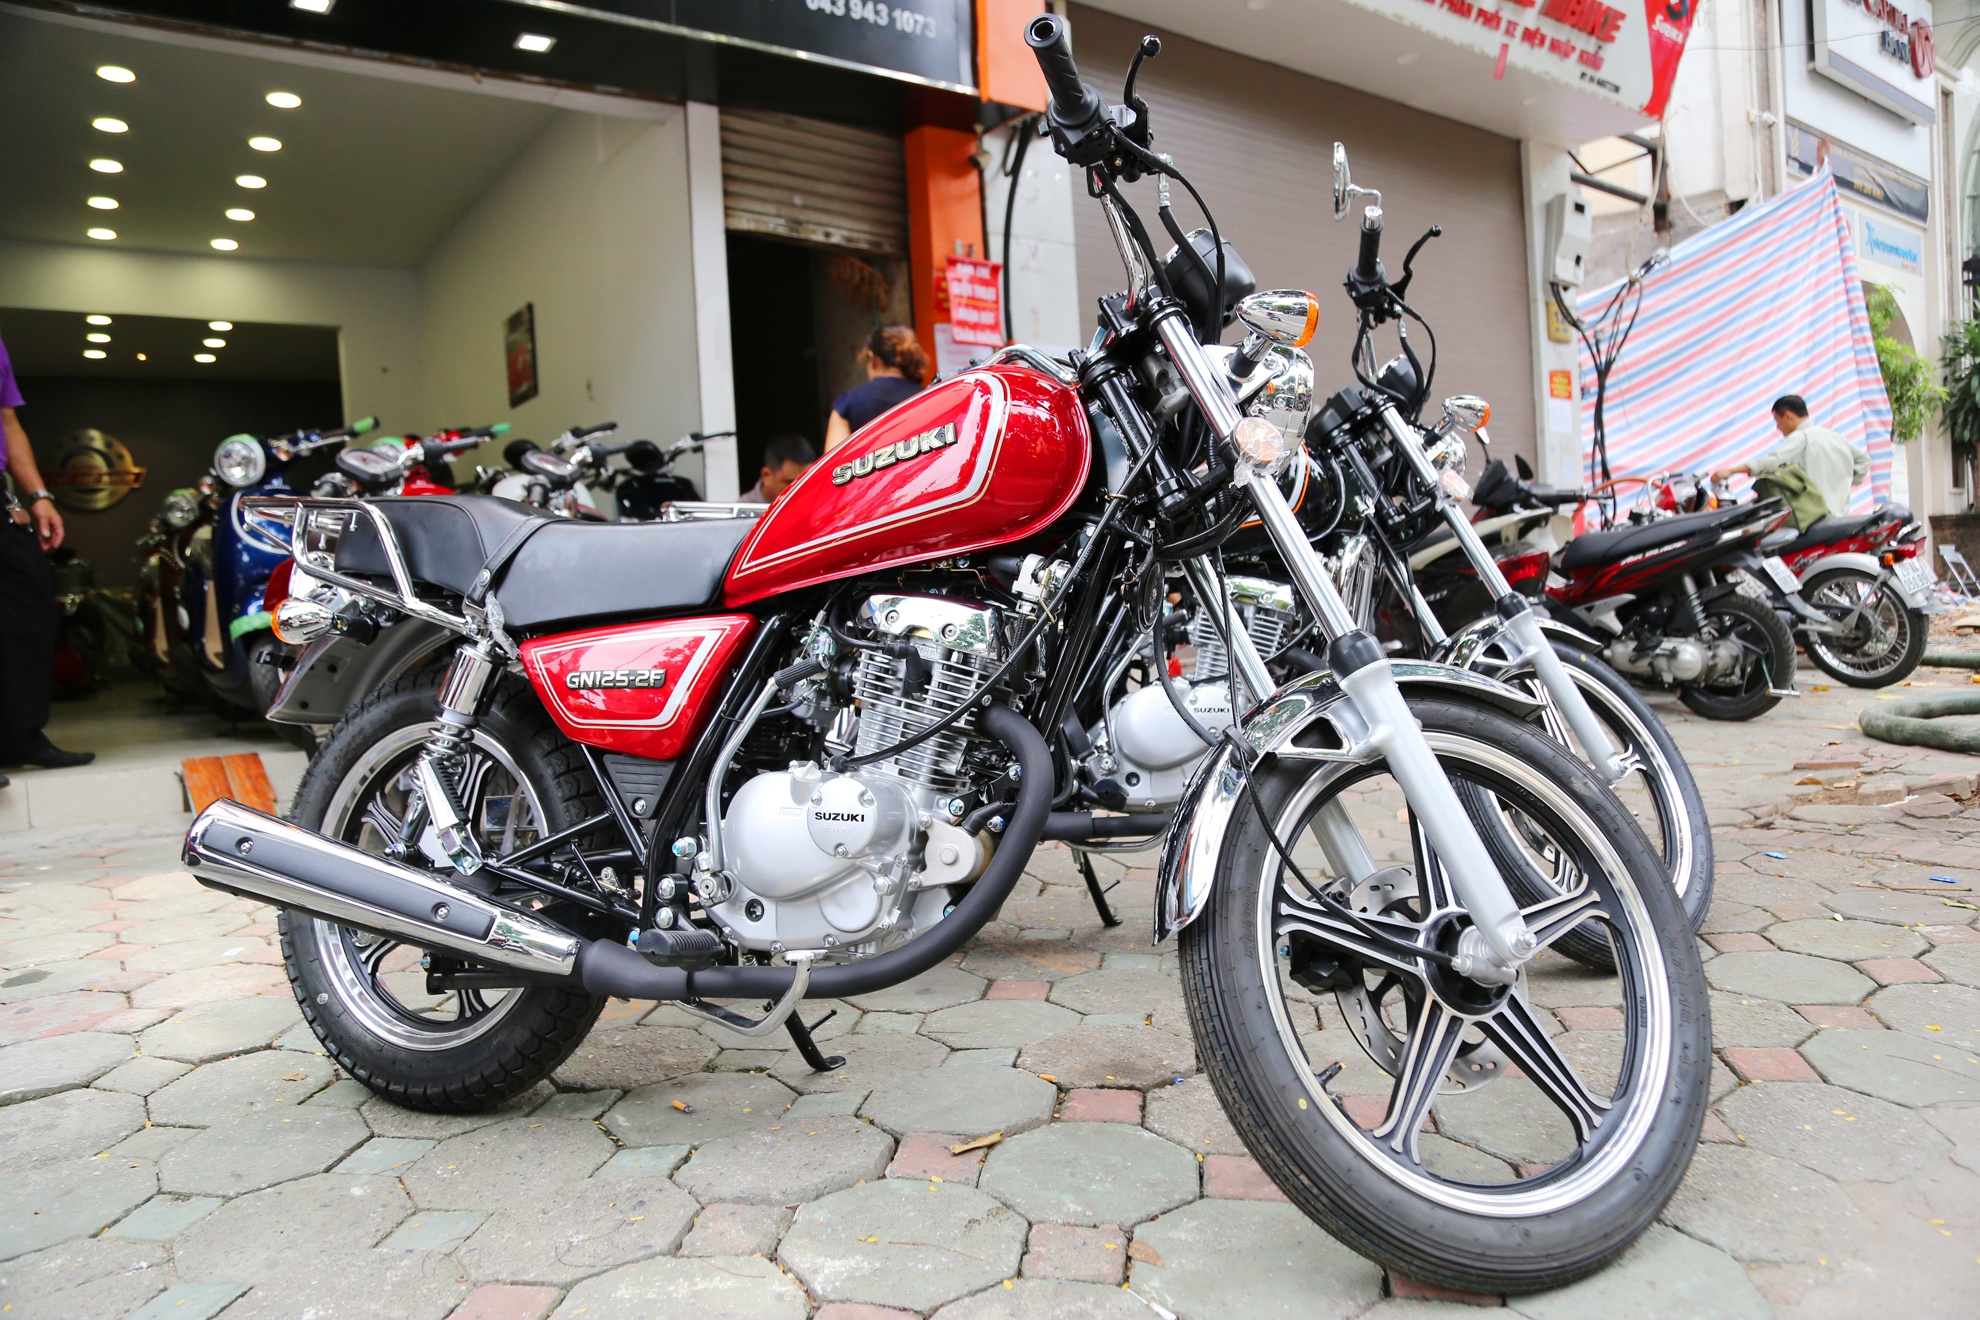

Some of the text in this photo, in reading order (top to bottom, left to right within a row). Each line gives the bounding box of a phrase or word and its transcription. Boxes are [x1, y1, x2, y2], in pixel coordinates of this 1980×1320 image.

[850, 0, 889, 27] 943
[892, 7, 937, 39] 1073
[832, 422, 957, 486] SUZUKI
[565, 669, 665, 689] GN125-2F
[814, 811, 865, 822] SUZUKI
